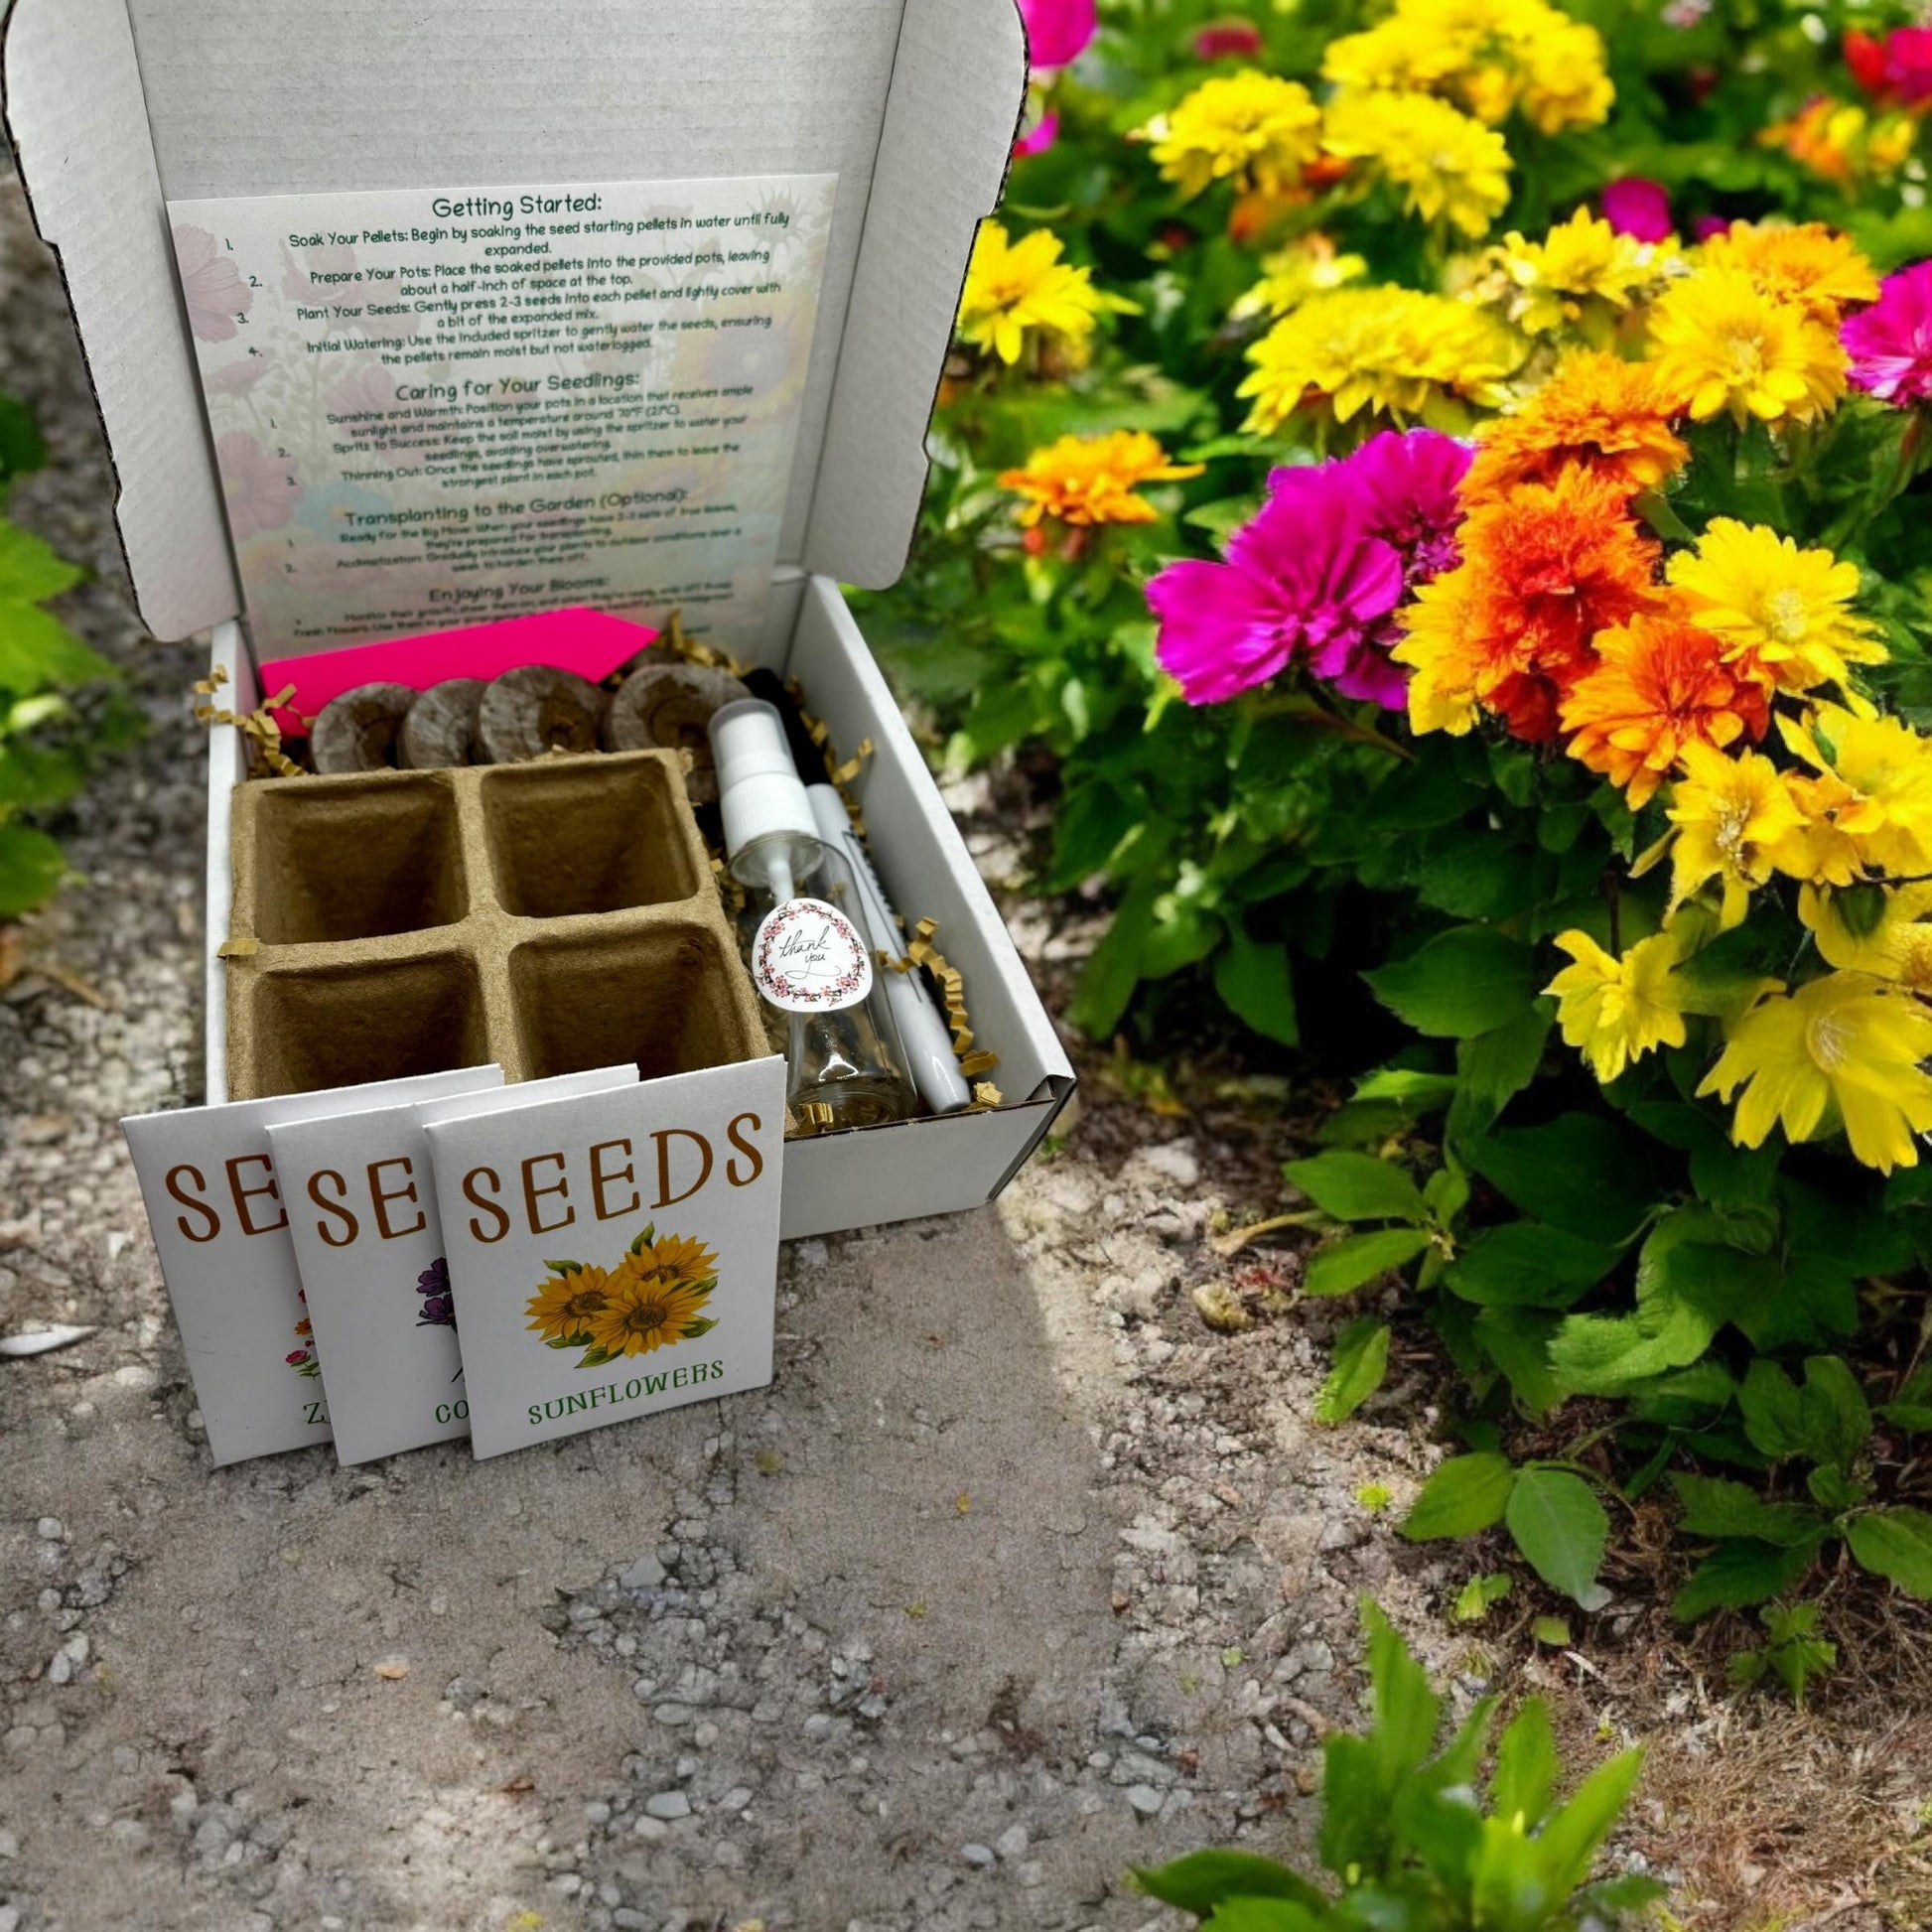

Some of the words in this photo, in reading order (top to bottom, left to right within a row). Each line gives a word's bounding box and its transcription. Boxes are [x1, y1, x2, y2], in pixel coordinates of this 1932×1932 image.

[433, 198, 513, 221] Getting
[519, 195, 602, 214] Started:
[225, 238, 233, 250] 1.
[288, 233, 325, 246] Soak
[327, 232, 358, 244] Your
[362, 230, 408, 243] Pellets:
[411, 227, 448, 243] Begin
[451, 227, 467, 242] by
[471, 224, 520, 239] soaking
[524, 223, 545, 235] the
[548, 221, 580, 234] seed
[584, 219, 633, 234] starting
[636, 217, 677, 233] pellets
[679, 216, 692, 228] in
[695, 215, 731, 227] water
[734, 213, 760, 226] until
[763, 212, 789, 227] fully
[483, 241, 551, 259] expanded.
[248, 276, 263, 288] 2.
[310, 271, 362, 285] Prepare
[365, 268, 395, 280] Your
[399, 266, 431, 278] Pots:
[434, 264, 466, 276] Place
[469, 262, 490, 274] the
[494, 259, 540, 273] soaked
[542, 258, 583, 274] pellets
[587, 256, 612, 268] into
[616, 255, 635, 267] the
[638, 252, 693, 269] provided
[694, 251, 725, 267] pots,
[727, 249, 769, 263] leaving
[399, 283, 436, 296] about
[441, 285, 448, 294] a
[451, 278, 507, 293] half-inch
[511, 277, 526, 290] of
[529, 279, 566, 292] space
[570, 275, 582, 287] at
[586, 274, 606, 286] the
[610, 273, 632, 287] top.
[236, 313, 249, 324] 3.
[296, 307, 329, 319] Plant
[332, 306, 362, 317] Your
[366, 303, 410, 315] Seeds:
[414, 300, 458, 314] Gently
[461, 300, 495, 313] press
[499, 296, 521, 308] 2-3
[524, 294, 561, 306] seeds
[565, 293, 590, 304] into
[592, 290, 621, 302] each
[623, 289, 656, 304] pellet
[659, 287, 683, 299] and
[685, 285, 719, 300] lightly
[721, 286, 754, 295] cover
[756, 281, 780, 293] with
[447, 316, 464, 327] bit
[469, 314, 483, 326] of
[487, 313, 507, 325] the
[510, 309, 572, 326] expanded
[248, 347, 263, 357] 4.
[306, 340, 341, 352] Initial
[344, 337, 405, 350] Watering:
[407, 335, 432, 345] Use
[435, 333, 456, 345] the
[459, 329, 509, 343] included
[512, 328, 560, 343] spritzer
[565, 326, 578, 337] to
[581, 323, 618, 339] gently
[620, 322, 654, 333] water
[658, 320, 678, 331] the
[680, 318, 718, 330] seeds,
[720, 315, 771, 329] ensuring
[380, 352, 401, 364] the
[403, 350, 445, 366] pellets
[448, 347, 490, 360] remain
[492, 345, 526, 357] moist
[529, 344, 549, 355] but
[552, 343, 574, 353] not
[395, 384, 457, 401] Caring
[463, 381, 492, 396] for
[498, 379, 541, 393] Your
[547, 372, 639, 390] Seedlings:
[344, 506, 469, 526] Transplanting
[473, 504, 491, 516] to
[496, 501, 524, 514] the
[528, 496, 596, 512] Garden
[599, 487, 688, 510] (Optional):
[428, 586, 503, 604] Enjoying
[508, 583, 544, 595] Your
[549, 579, 609, 591] Blooms:
[778, 925, 831, 958] thank
[462, 1112, 763, 1243] SEEDS
[527, 1359, 725, 1425] SUNFLOWERS
